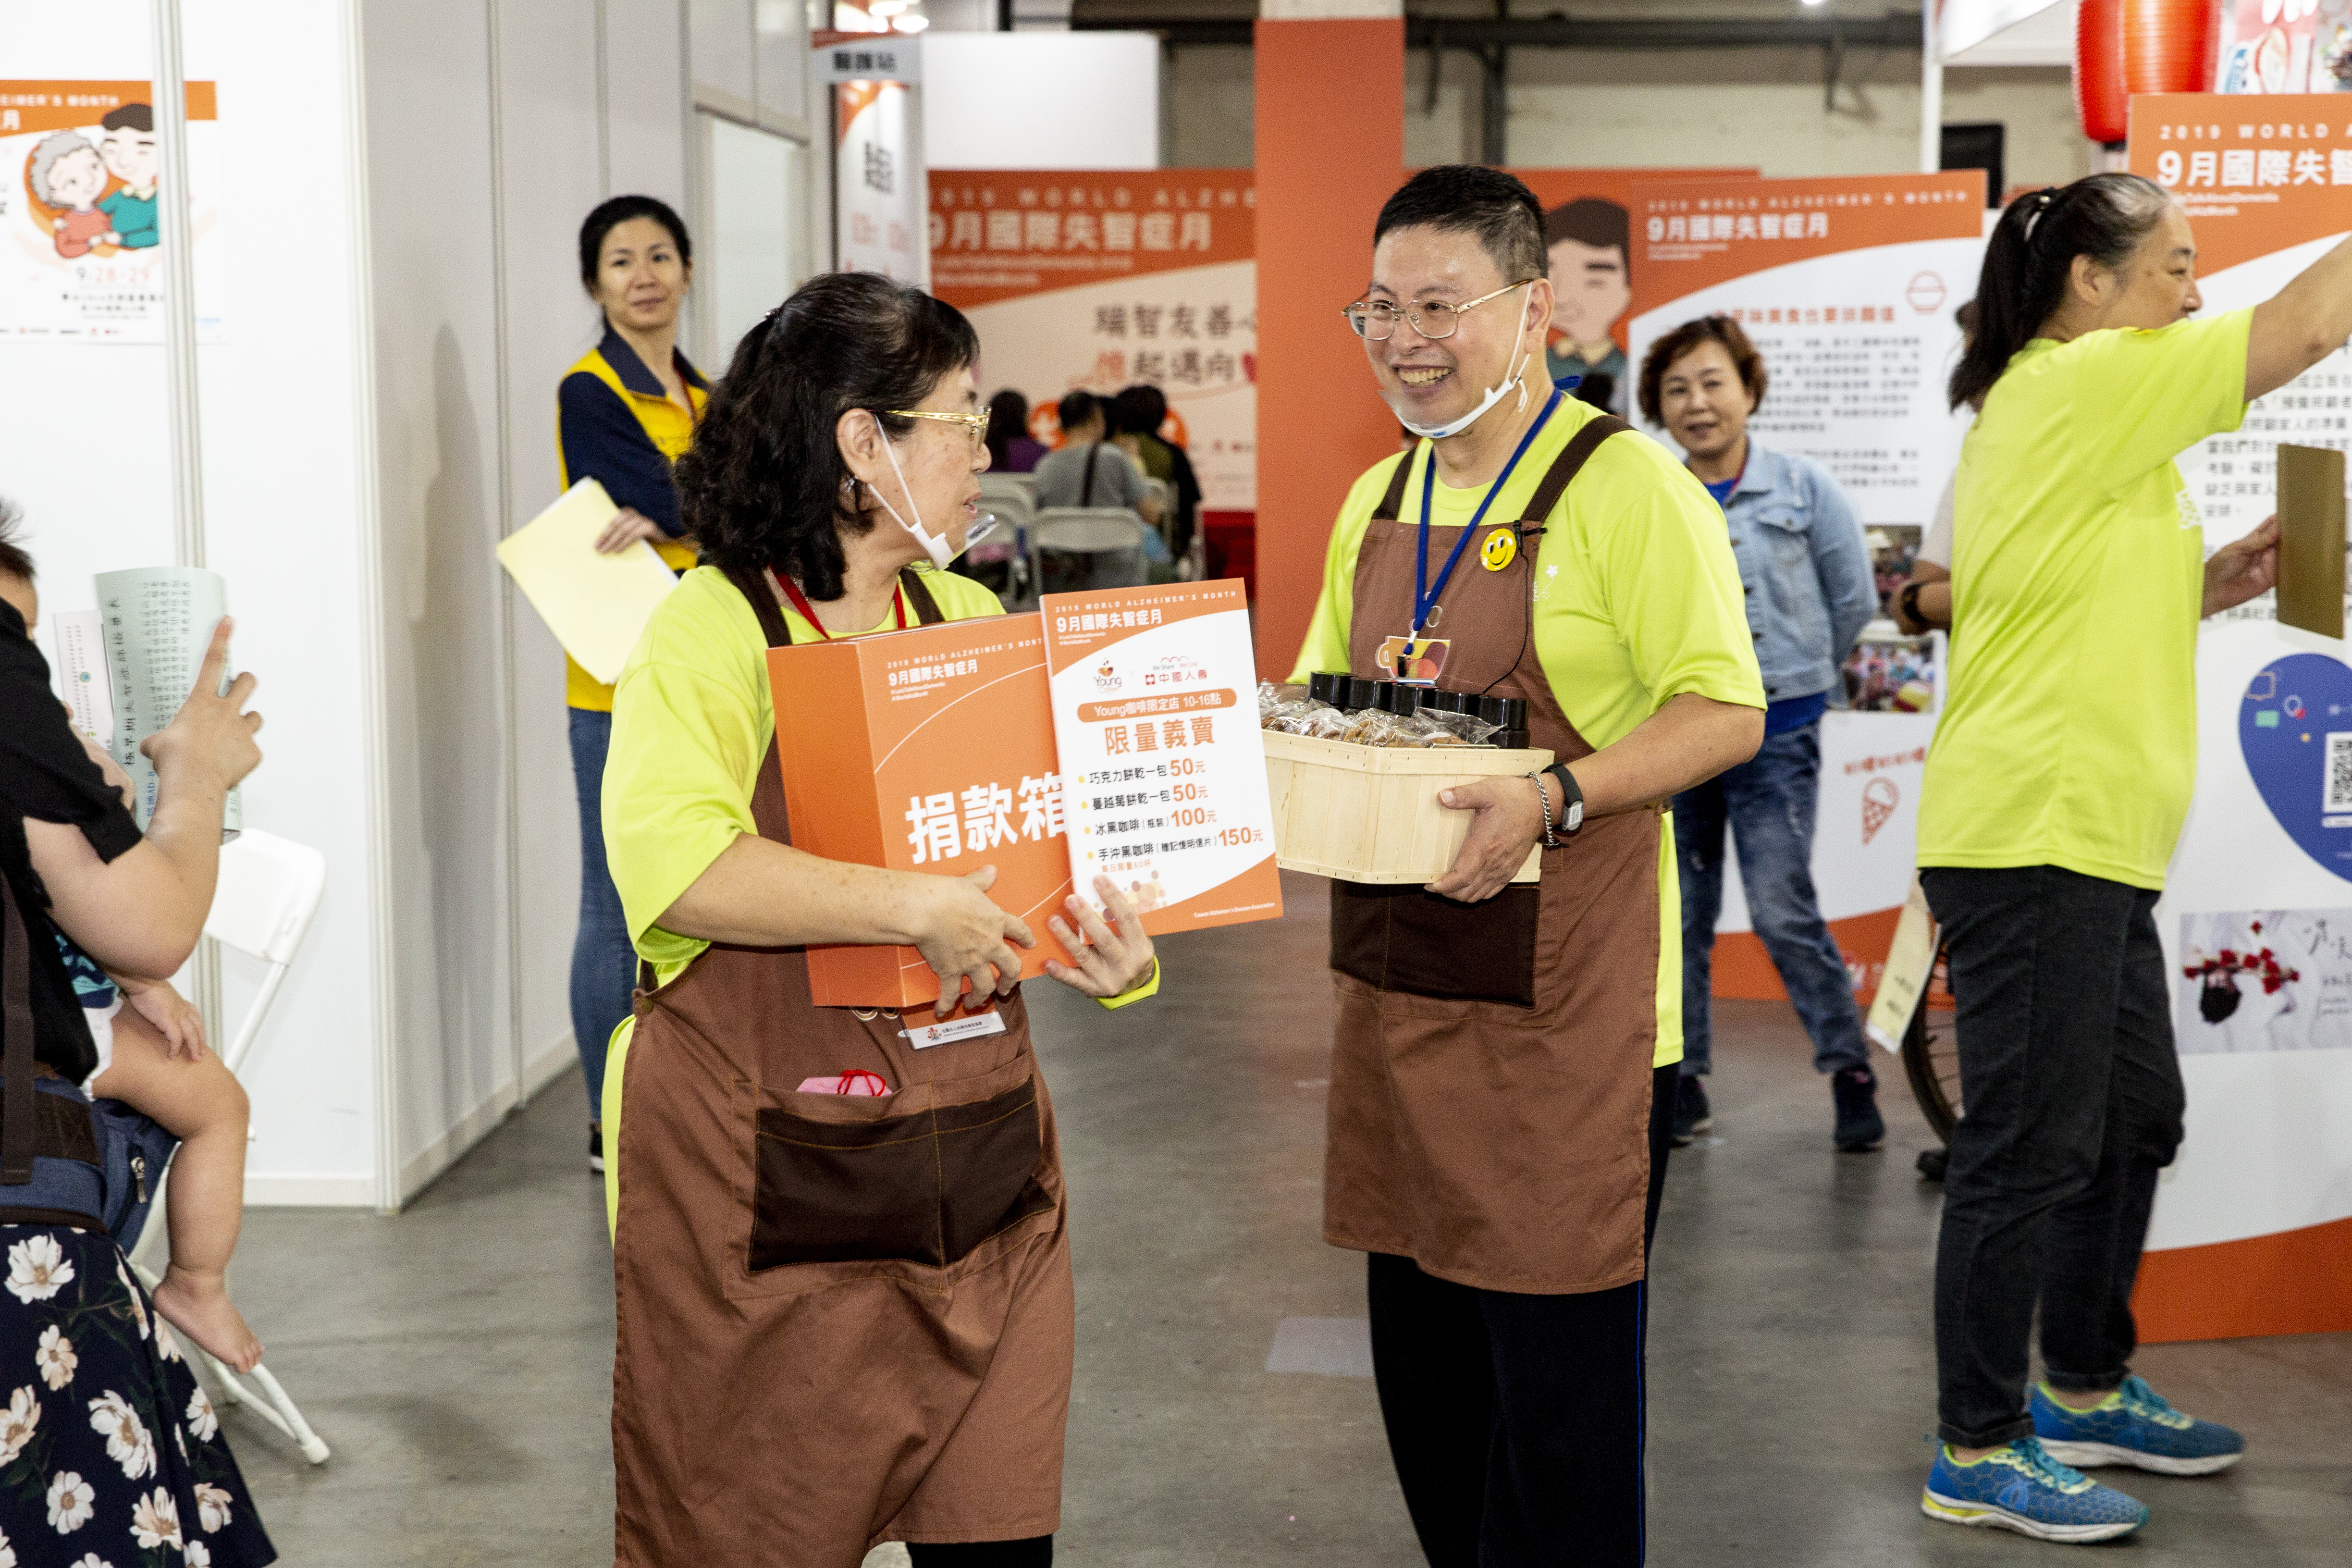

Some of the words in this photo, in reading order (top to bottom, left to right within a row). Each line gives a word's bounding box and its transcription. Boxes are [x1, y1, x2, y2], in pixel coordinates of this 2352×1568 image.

[2238, 123, 2329, 139] WORLD
[1647, 211, 1828, 243] 9月國際失智症月
[1055, 605, 1079, 613] 2019
[1085, 601, 1120, 610] WORLD
[1127, 594, 1196, 606] ALZHEIMER'S
[1203, 591, 1236, 600] MONTH
[1057, 608, 1162, 633] 9月國際失智症月
[914, 653, 946, 664] WORLD
[950, 642, 1013, 659] ALZHEIMER'S
[1018, 638, 1042, 647] MONT
[889, 659, 978, 686] 9月國際失智症月
[1094, 675, 1122, 688] Young
[1159, 669, 1207, 683] 中國人壽
[1094, 697, 1179, 717] Young咖啡限定店
[1183, 692, 1221, 707] 10-16點
[1105, 716, 1215, 756] 限量義賣
[1089, 758, 1205, 784] 巧克力餅乾一包50元
[905, 771, 1066, 864] 捐款箱
